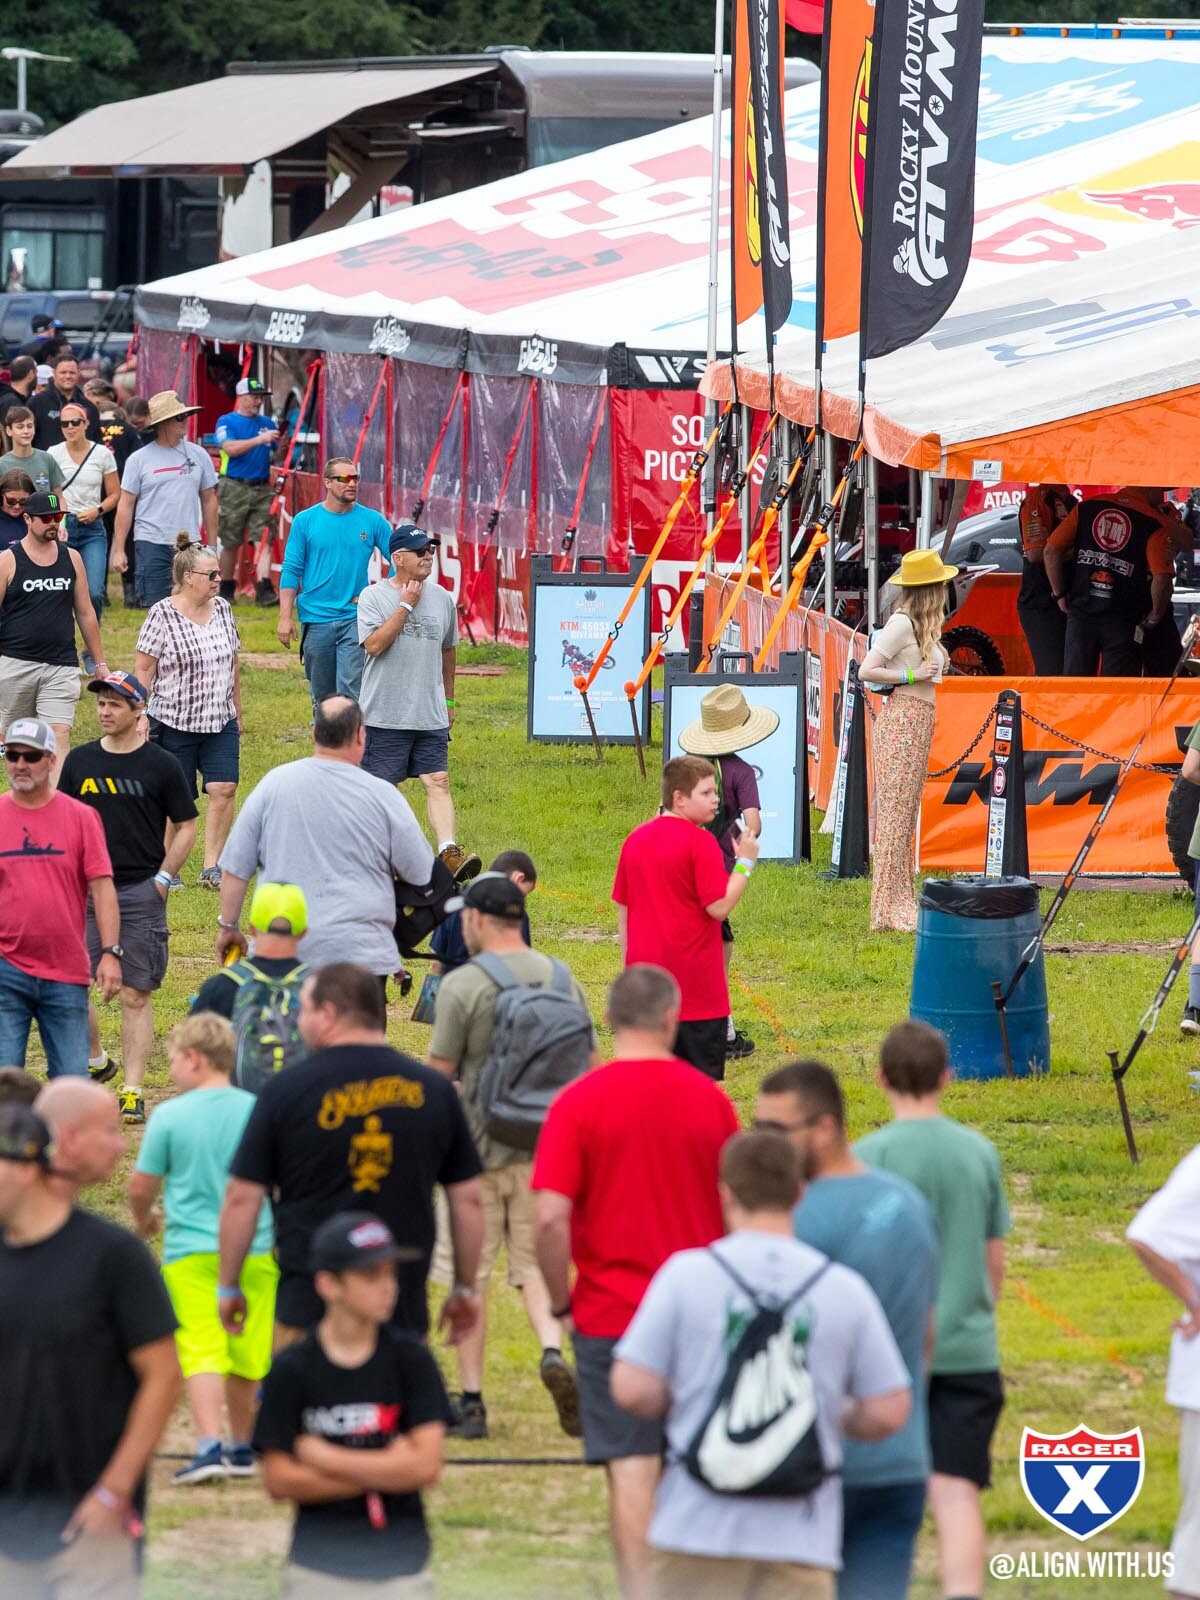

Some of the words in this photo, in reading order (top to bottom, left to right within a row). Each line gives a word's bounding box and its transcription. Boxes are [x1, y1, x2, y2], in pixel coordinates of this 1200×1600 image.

[892, 118, 920, 232] ROCKY
[22, 577, 72, 593] OAKLEY
[560, 622, 579, 631] KTM
[943, 750, 1122, 805] KTM
